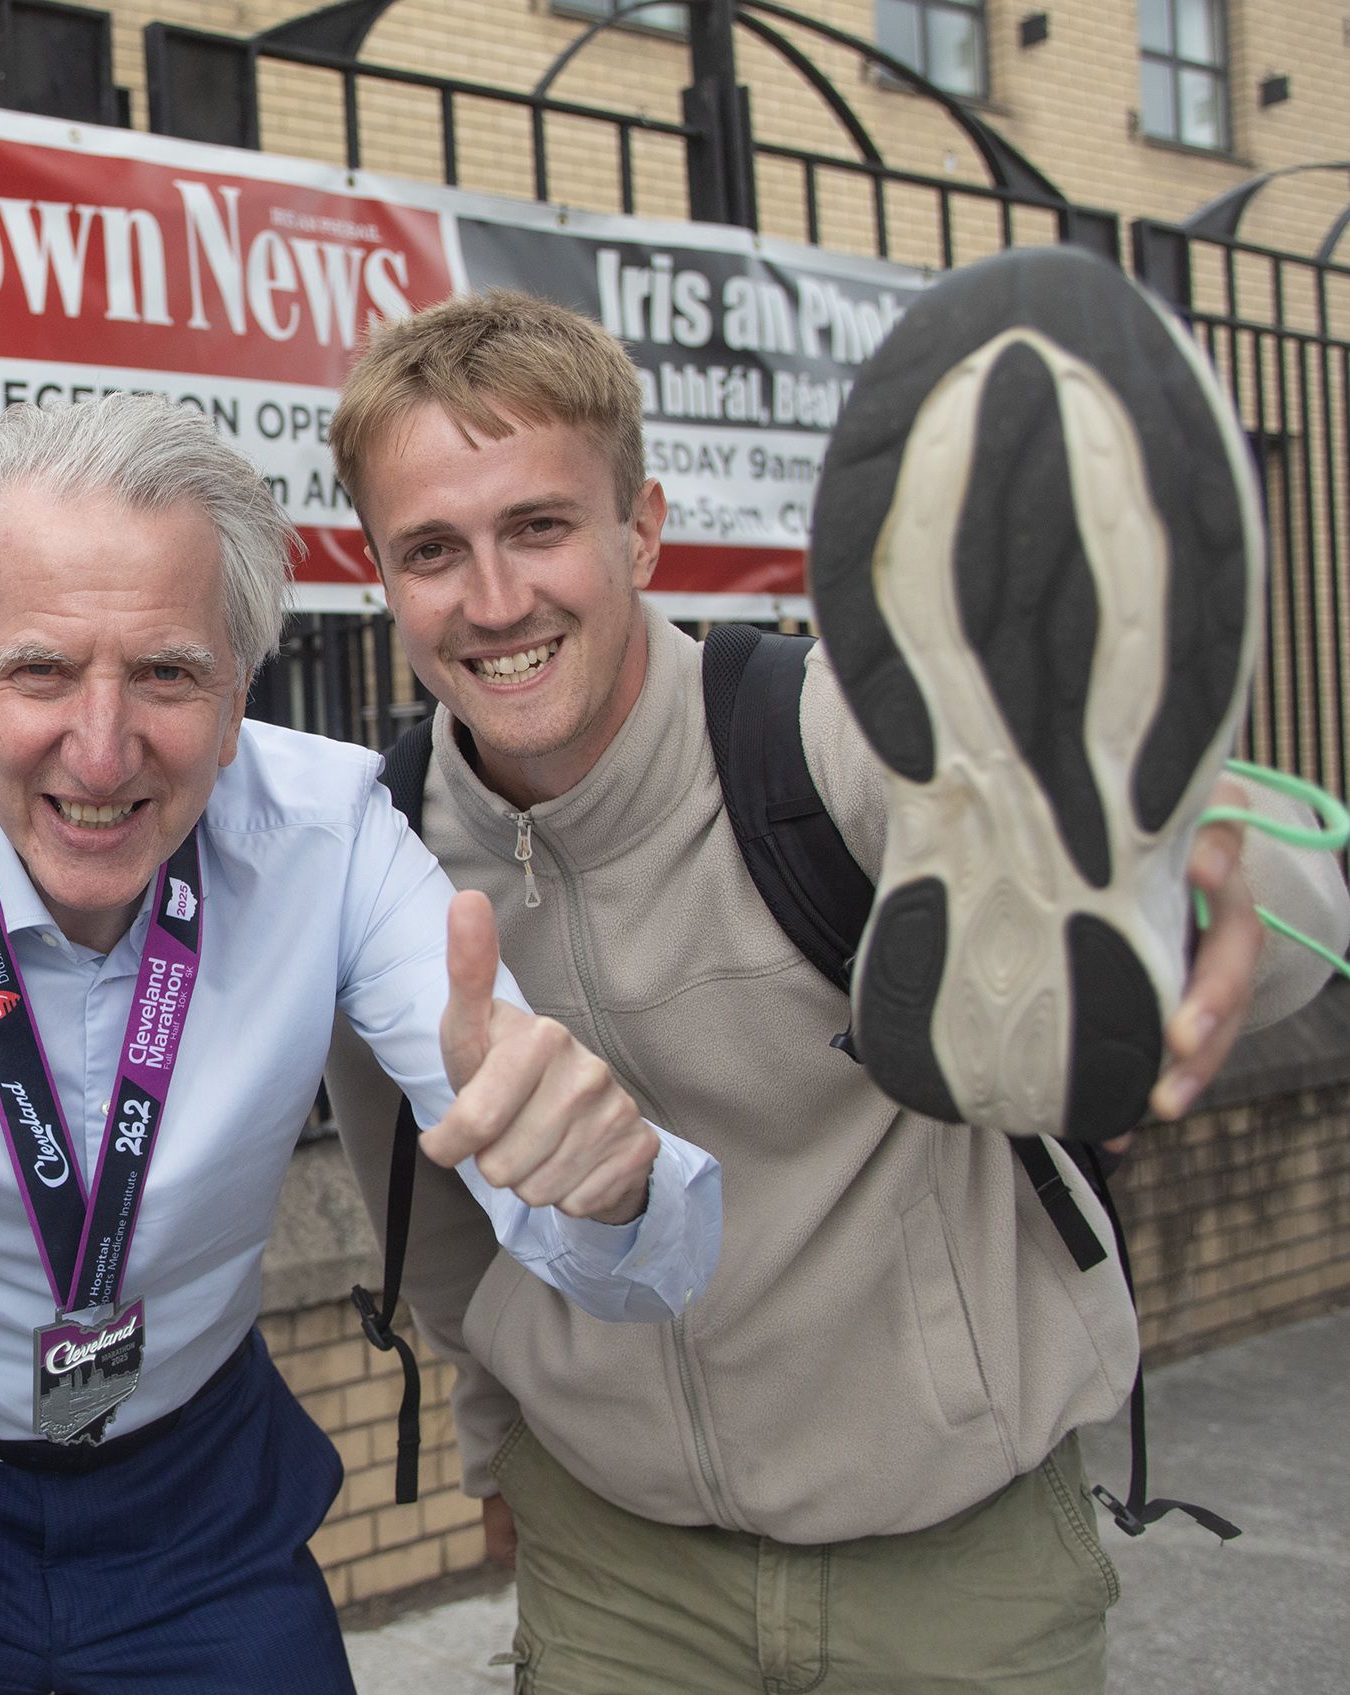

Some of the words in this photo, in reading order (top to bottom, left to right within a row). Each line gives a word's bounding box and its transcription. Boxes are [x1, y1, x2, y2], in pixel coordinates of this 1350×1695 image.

[172, 178, 414, 350] News
[596, 248, 712, 348] Iris
[723, 275, 795, 352] an
[257, 402, 334, 443] OPE
[645, 440, 737, 478] SDAY
[304, 471, 353, 509] AN
[176, 885, 189, 917] 2025
[128, 957, 167, 1064] Cleveland
[146, 963, 185, 1069] Marathon
[163, 1053, 173, 1070] Full
[169, 1021, 181, 1040] Half
[178, 991, 188, 1008] 10K
[0, 1081, 70, 1188] Cleveland
[115, 1099, 152, 1156] 26.2
[118, 1170, 138, 1217] Institute
[90, 1236, 111, 1296] Hospitals
[107, 1219, 127, 1271] Medicine
[101, 1273, 115, 1304] ports
[46, 1315, 138, 1375] Cleveland
[101, 1341, 137, 1362] MARATHON
[111, 1352, 129, 1367] 2025
